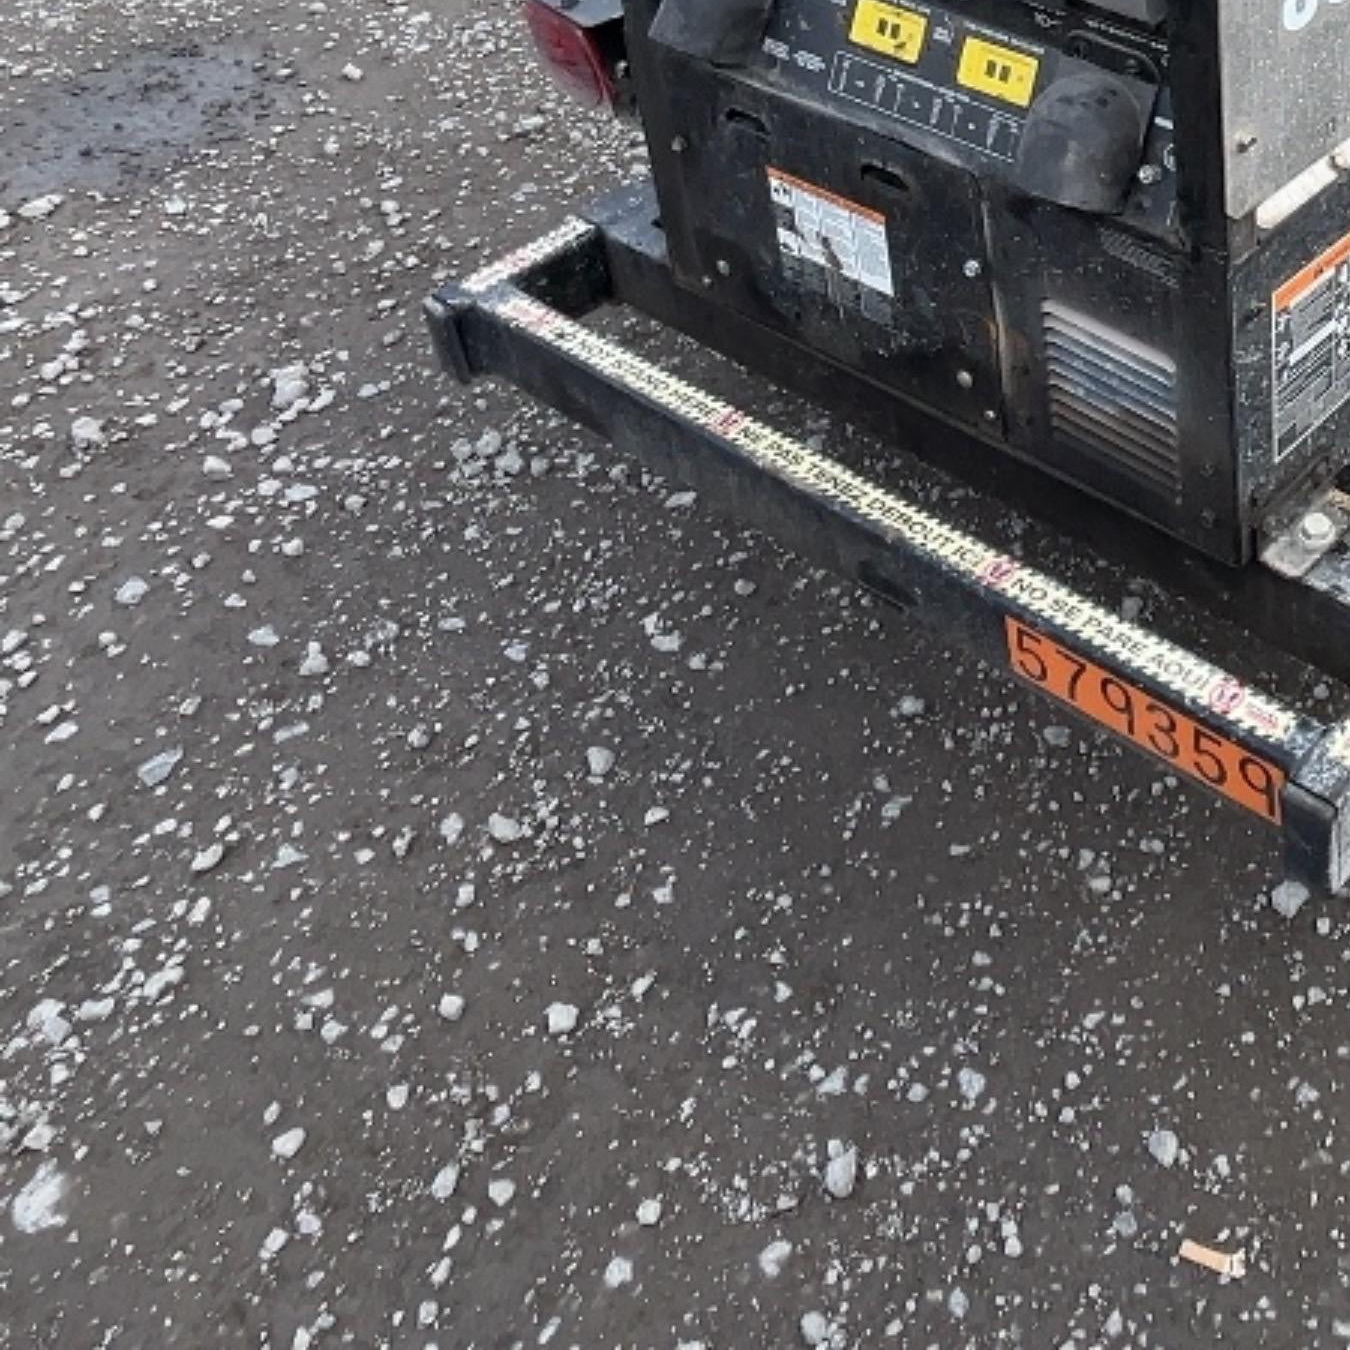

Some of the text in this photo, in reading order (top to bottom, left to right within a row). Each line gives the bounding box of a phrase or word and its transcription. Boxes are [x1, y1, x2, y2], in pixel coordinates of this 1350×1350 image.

[805, 461, 867, 503] TENEZ
[866, 496, 954, 549] DEBOUT
[1010, 576, 1048, 602] NO
[1048, 598, 1086, 621] SE
[1081, 613, 1147, 659] PARE
[1016, 626, 1277, 820] 579359
